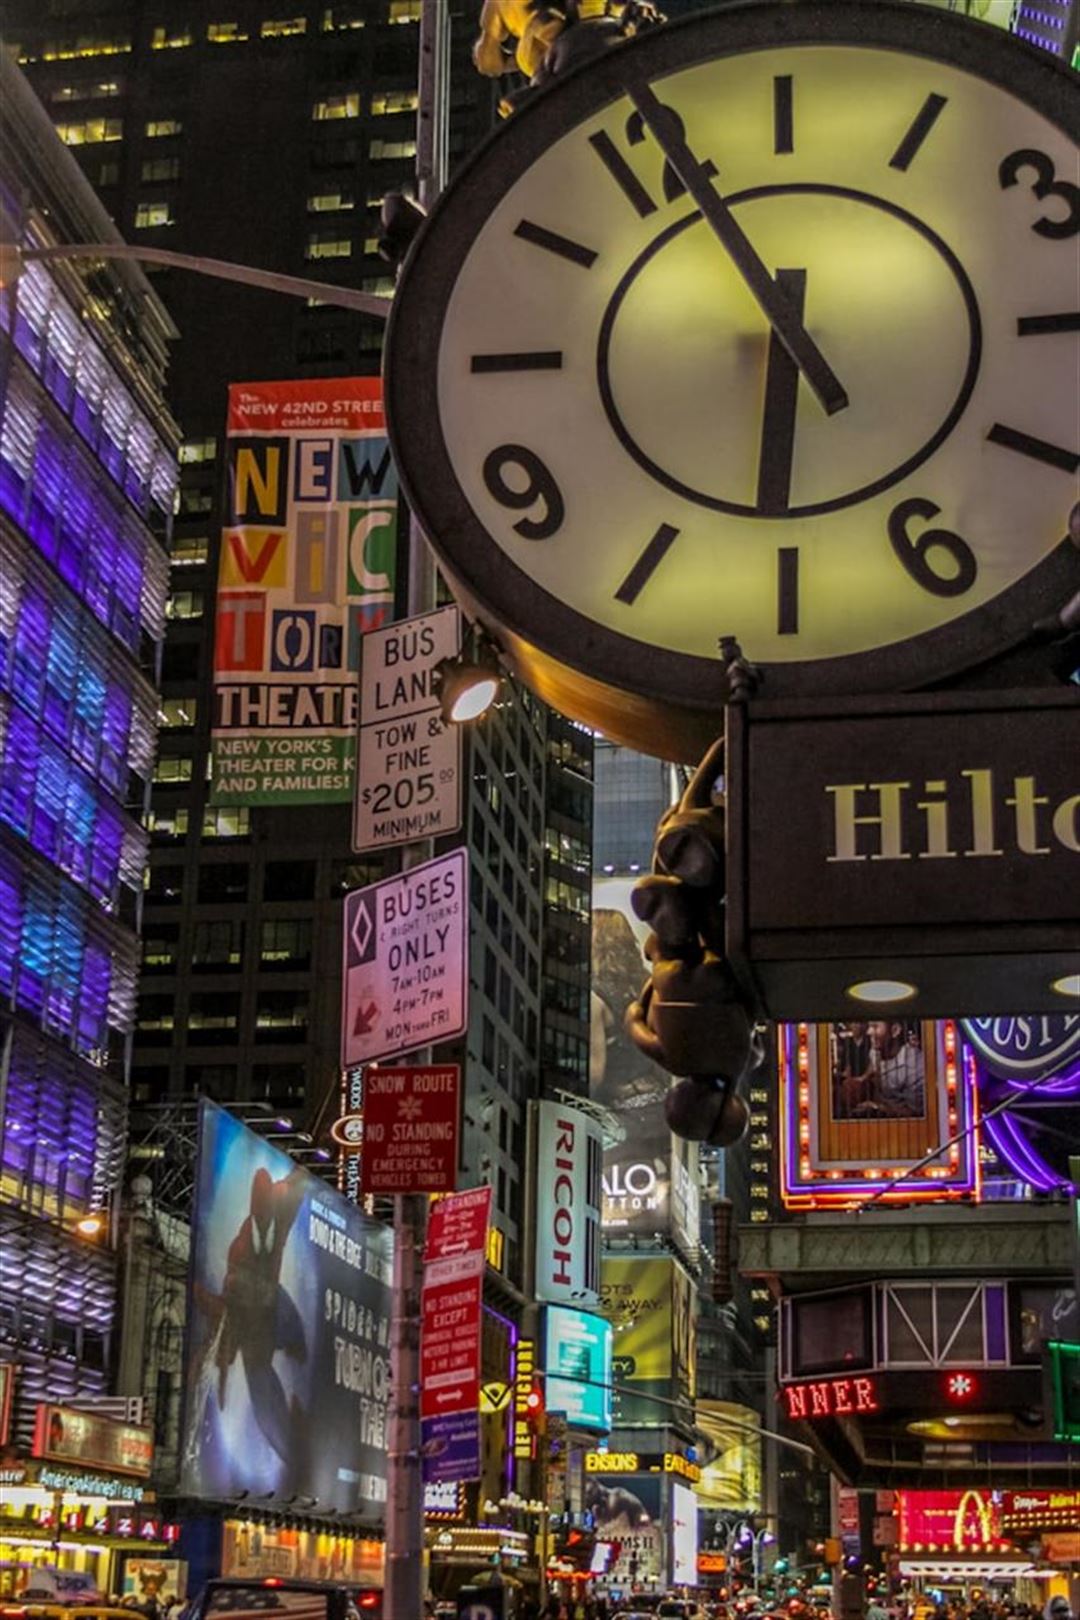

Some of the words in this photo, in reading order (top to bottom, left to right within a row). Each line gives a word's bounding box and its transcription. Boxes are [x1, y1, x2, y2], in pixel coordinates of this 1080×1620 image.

[1000, 148, 1077, 241] 3
[238, 402, 278, 415] NEW
[283, 401, 328, 414] 42ND
[282, 416, 350, 427] celebrates
[235, 441, 391, 516] NEW
[482, 444, 566, 541] 9
[888, 497, 977, 598] 6
[384, 627, 436, 667] BUS
[217, 740, 260, 755] NEW
[266, 739, 333, 754] YORK'S
[375, 722, 418, 750] TOW
[427, 716, 442, 737] &
[217, 758, 296, 774] THEATER
[302, 757, 338, 772] FOR
[385, 745, 432, 775] FINE
[216, 778, 258, 793] AND
[262, 775, 350, 791] FAMILIES!
[373, 810, 442, 838] MINIMUM
[383, 871, 456, 924] BUSES
[388, 924, 450, 972] ONLY
[385, 1021, 411, 1041] MON
[431, 1007, 449, 1027] FRI
[369, 1074, 406, 1094] SNOW
[413, 1073, 455, 1092] ROUTE
[366, 1124, 385, 1142] NO
[393, 1122, 453, 1141] STANDING
[372, 1158, 445, 1171] EMERGENCY
[387, 1144, 431, 1157] DURING
[553, 1119, 574, 1286] RICOH
[433, 1307, 468, 1329] EXCEPT
[785, 1378, 878, 1418] NNER
